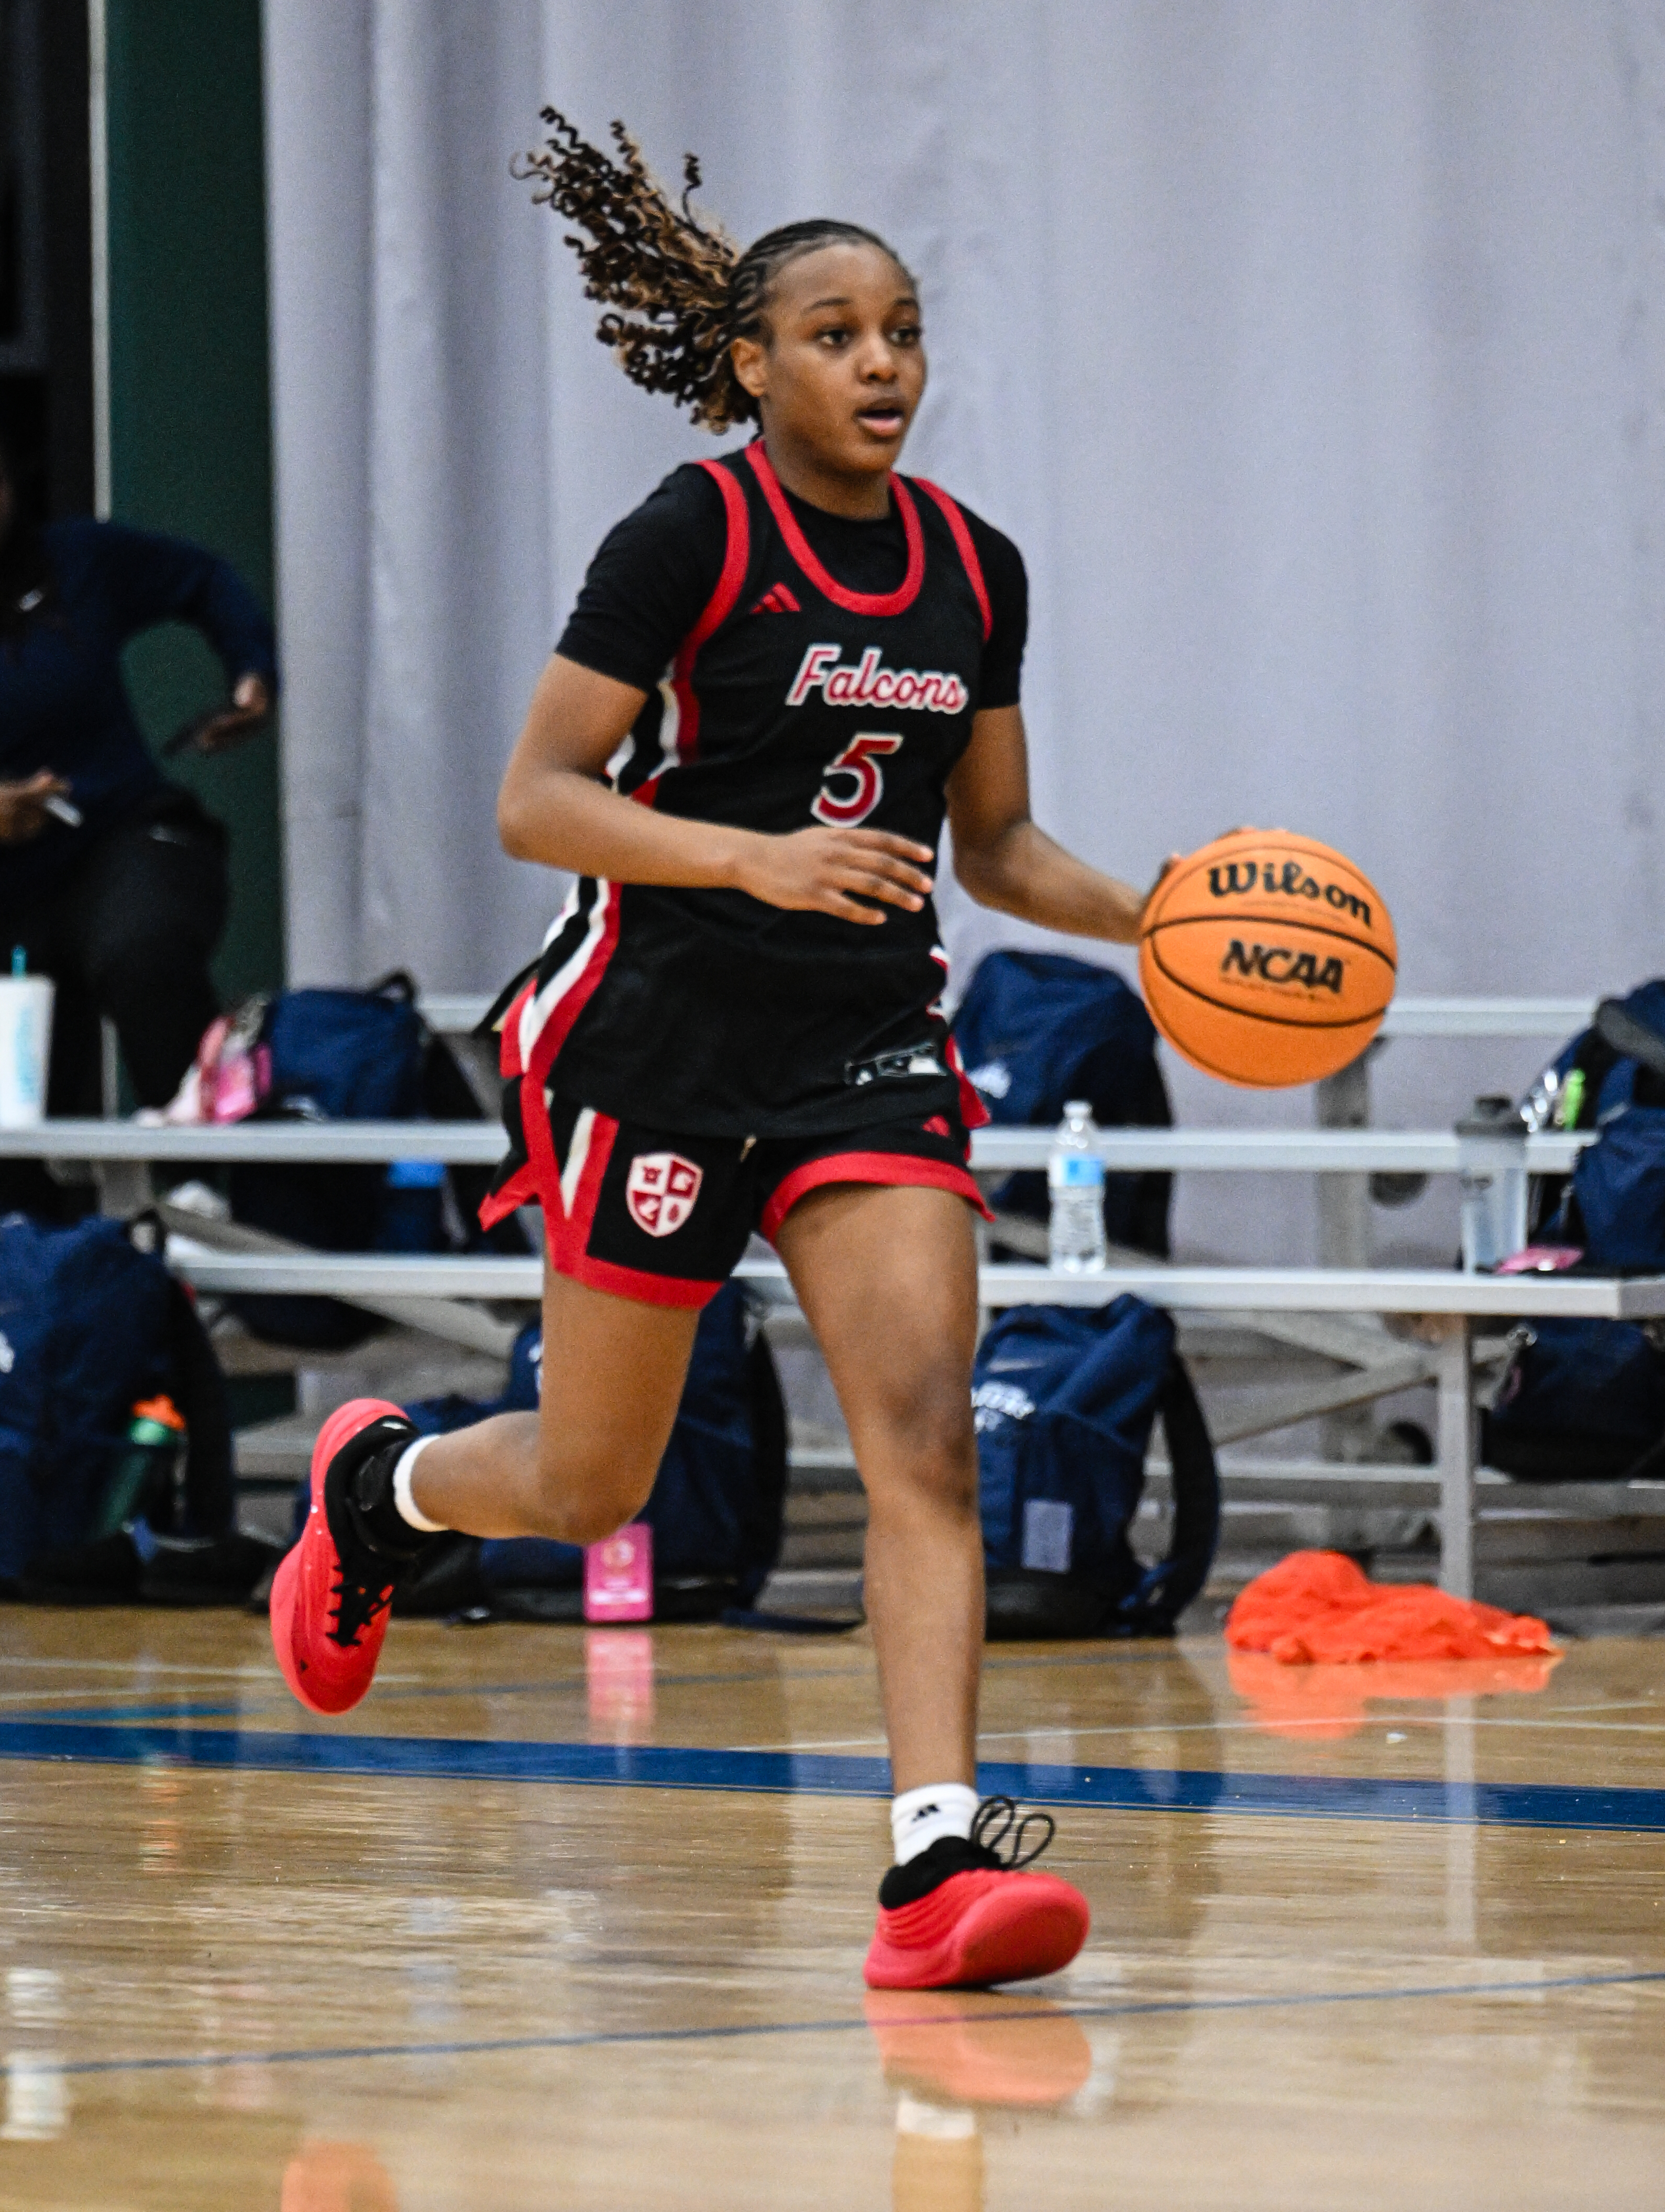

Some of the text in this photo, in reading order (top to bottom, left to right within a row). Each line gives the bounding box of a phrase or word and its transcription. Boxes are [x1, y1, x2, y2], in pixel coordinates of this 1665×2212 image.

[786, 643, 969, 714] Falcons
[810, 732, 903, 828] 5
[1208, 860, 1371, 927] Wilson
[1220, 939, 1343, 993] NCAA
